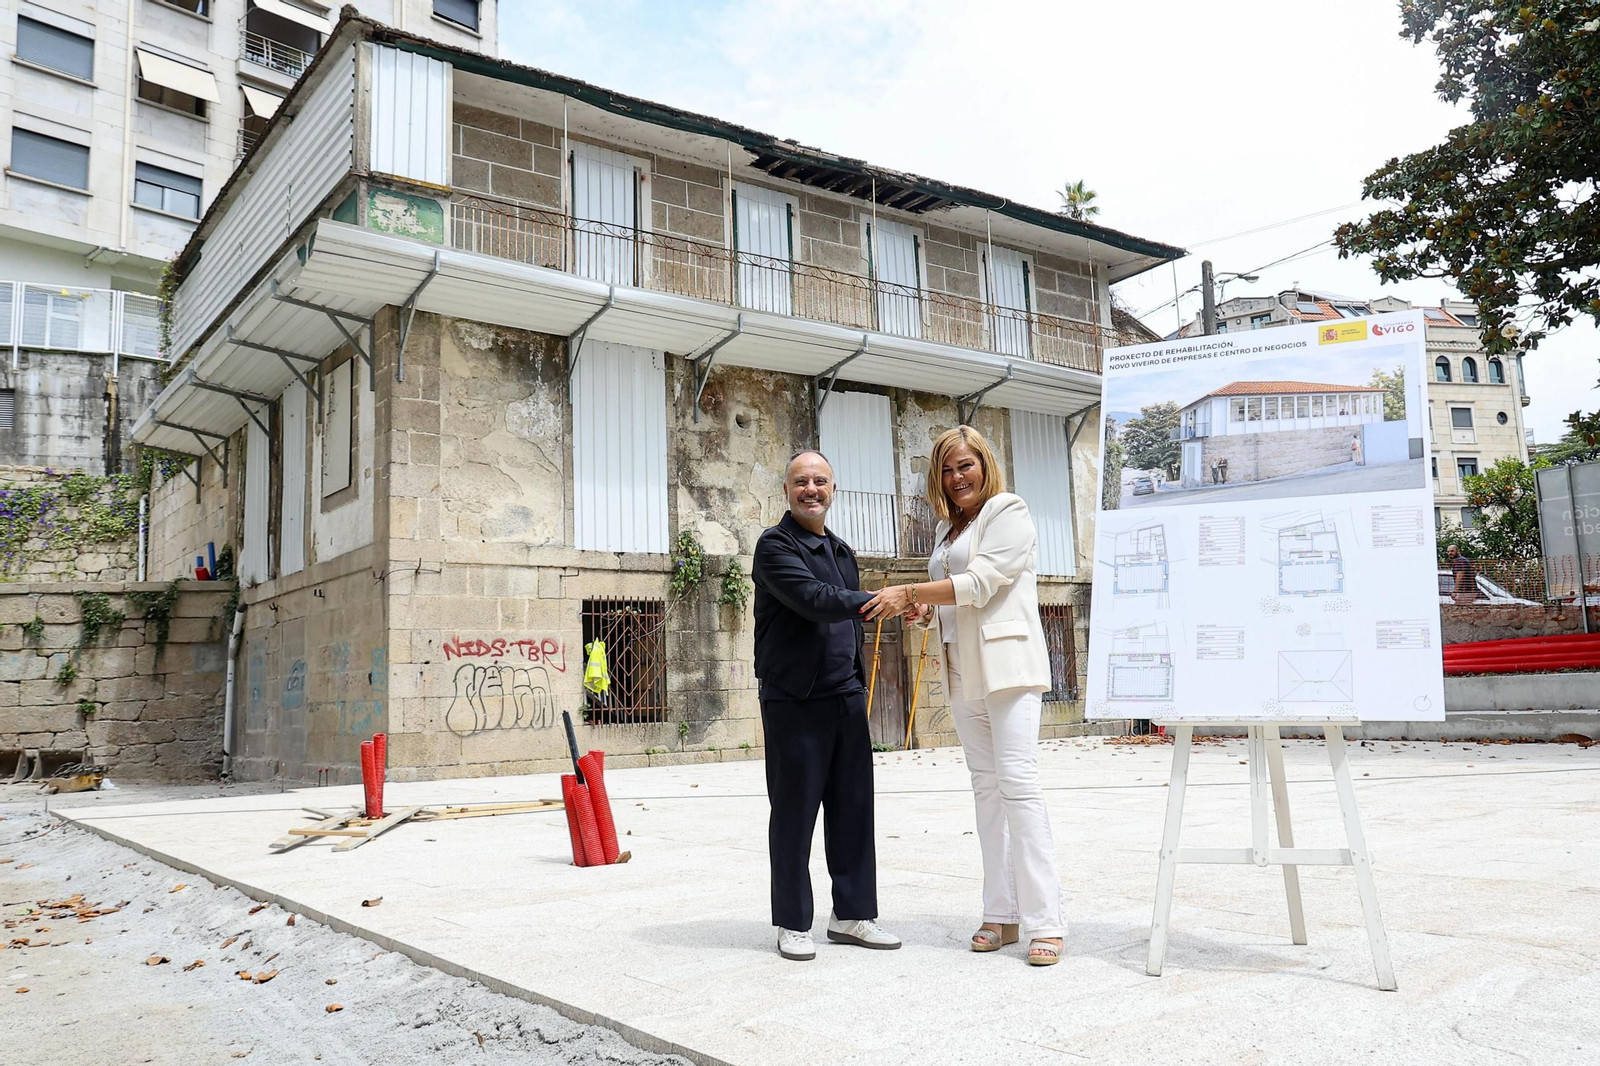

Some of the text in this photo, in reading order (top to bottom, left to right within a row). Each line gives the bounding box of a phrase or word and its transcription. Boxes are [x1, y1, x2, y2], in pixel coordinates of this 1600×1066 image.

[1384, 324, 1415, 334] VIGO
[1109, 362, 1130, 370] NOVO
[1132, 358, 1160, 368] VIVEIRO
[1172, 354, 1212, 363] EMPRESAS
[1220, 348, 1251, 357] CENTRO
[1264, 340, 1308, 352] NEGOCIOS
[1109, 351, 1152, 362] PROXECTO
